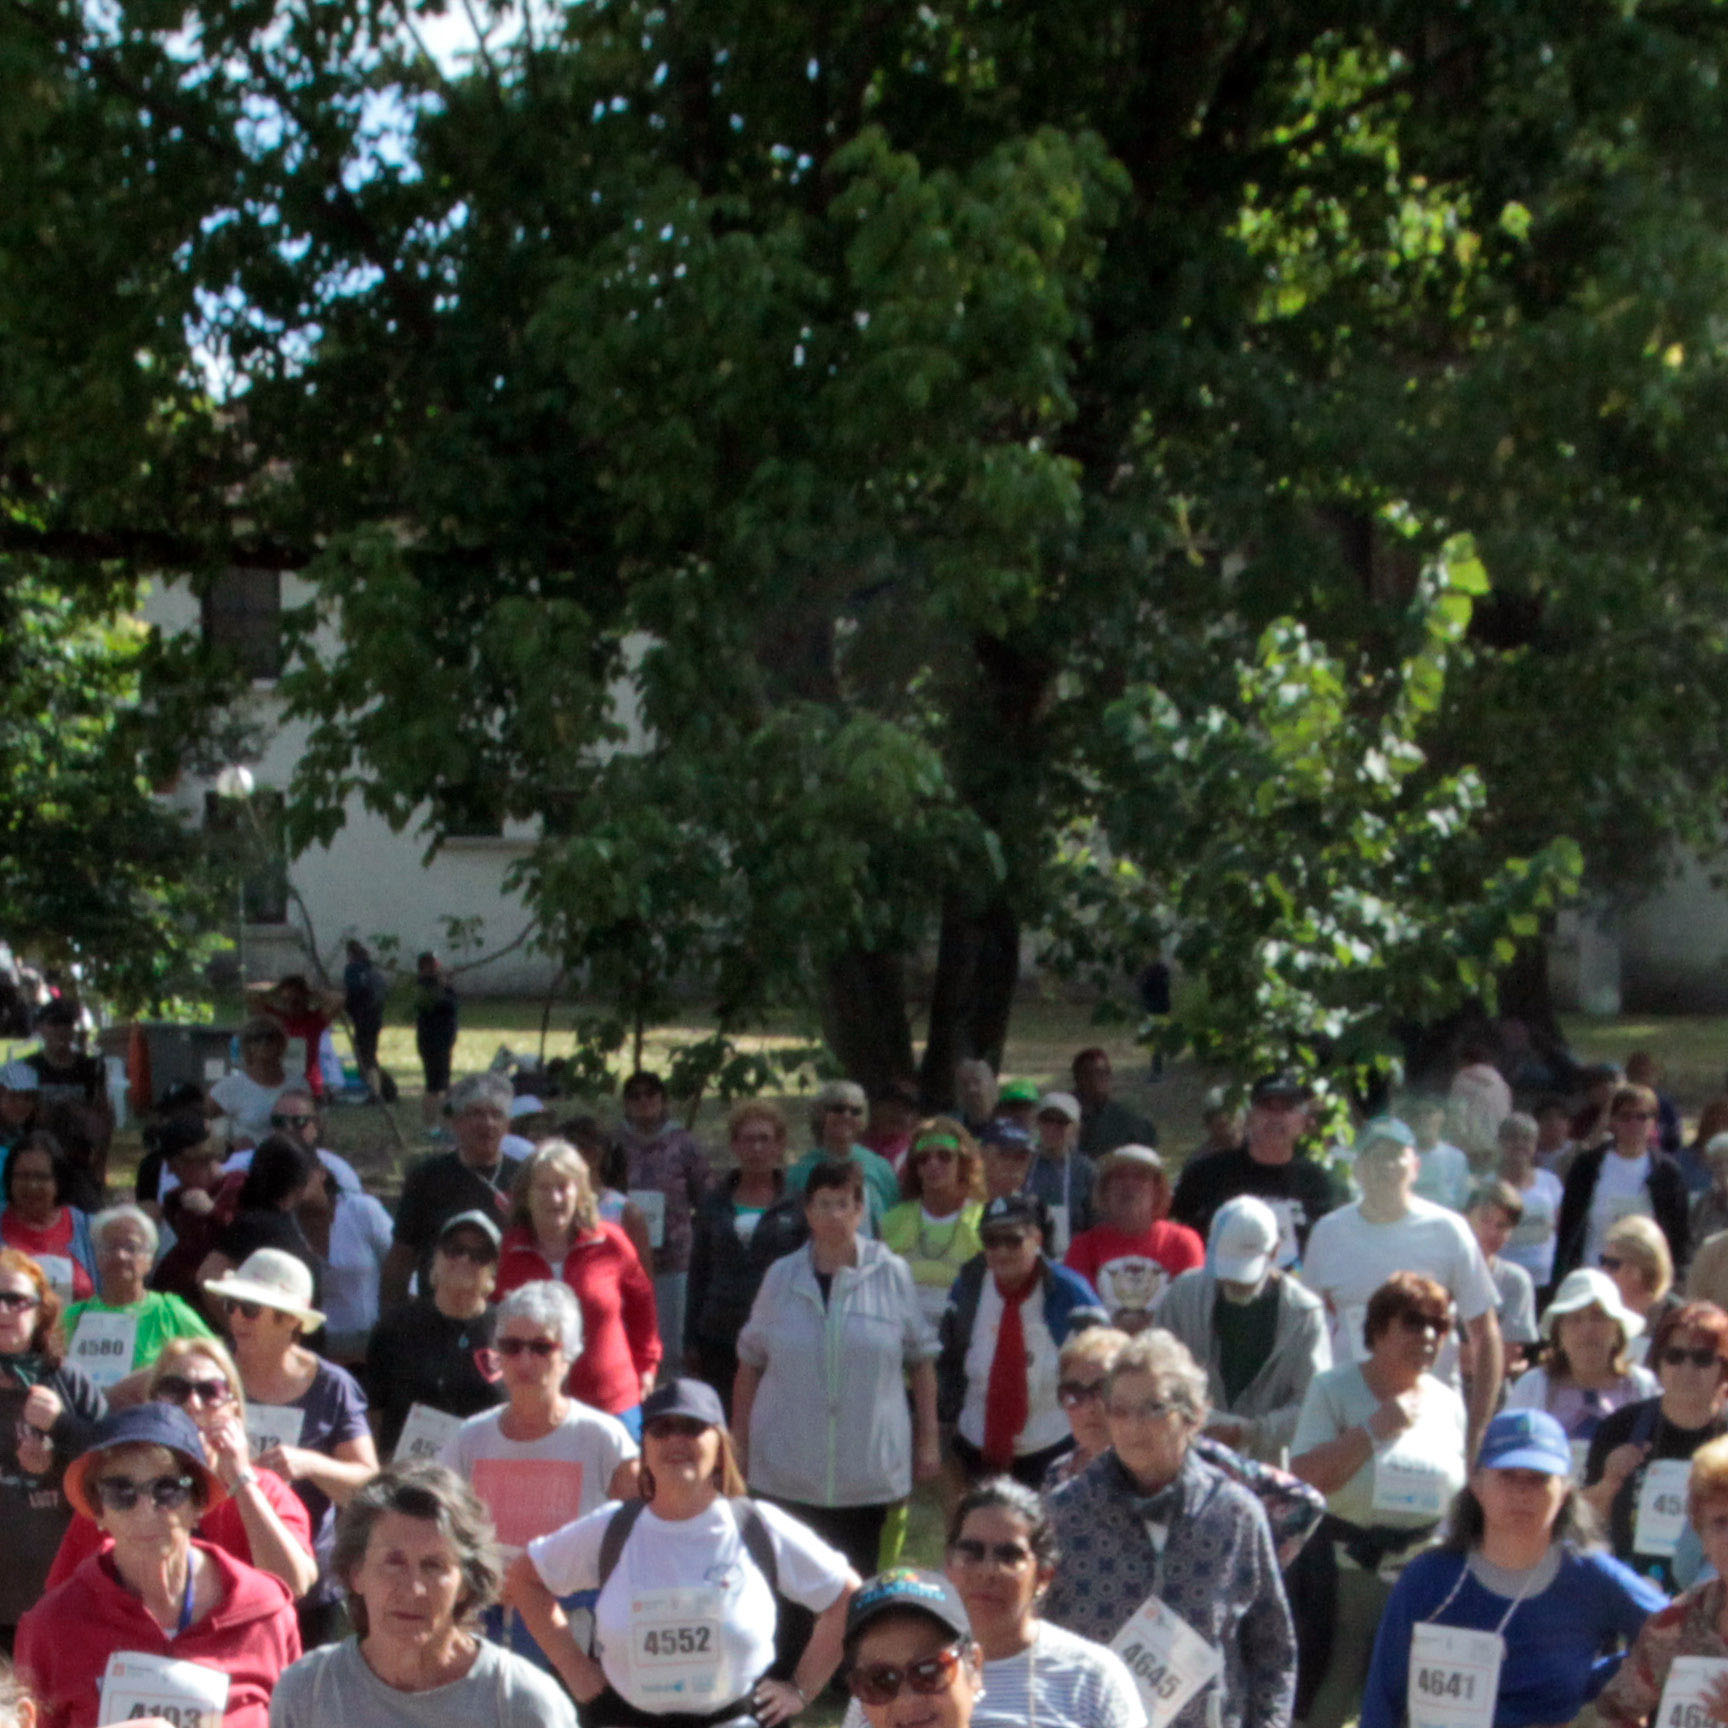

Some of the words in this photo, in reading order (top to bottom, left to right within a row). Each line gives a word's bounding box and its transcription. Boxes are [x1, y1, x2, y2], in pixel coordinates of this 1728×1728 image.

[643, 1626, 711, 1655] 4552
[1123, 1642, 1181, 1699] 4645
[1418, 1667, 1475, 1700] 4641
